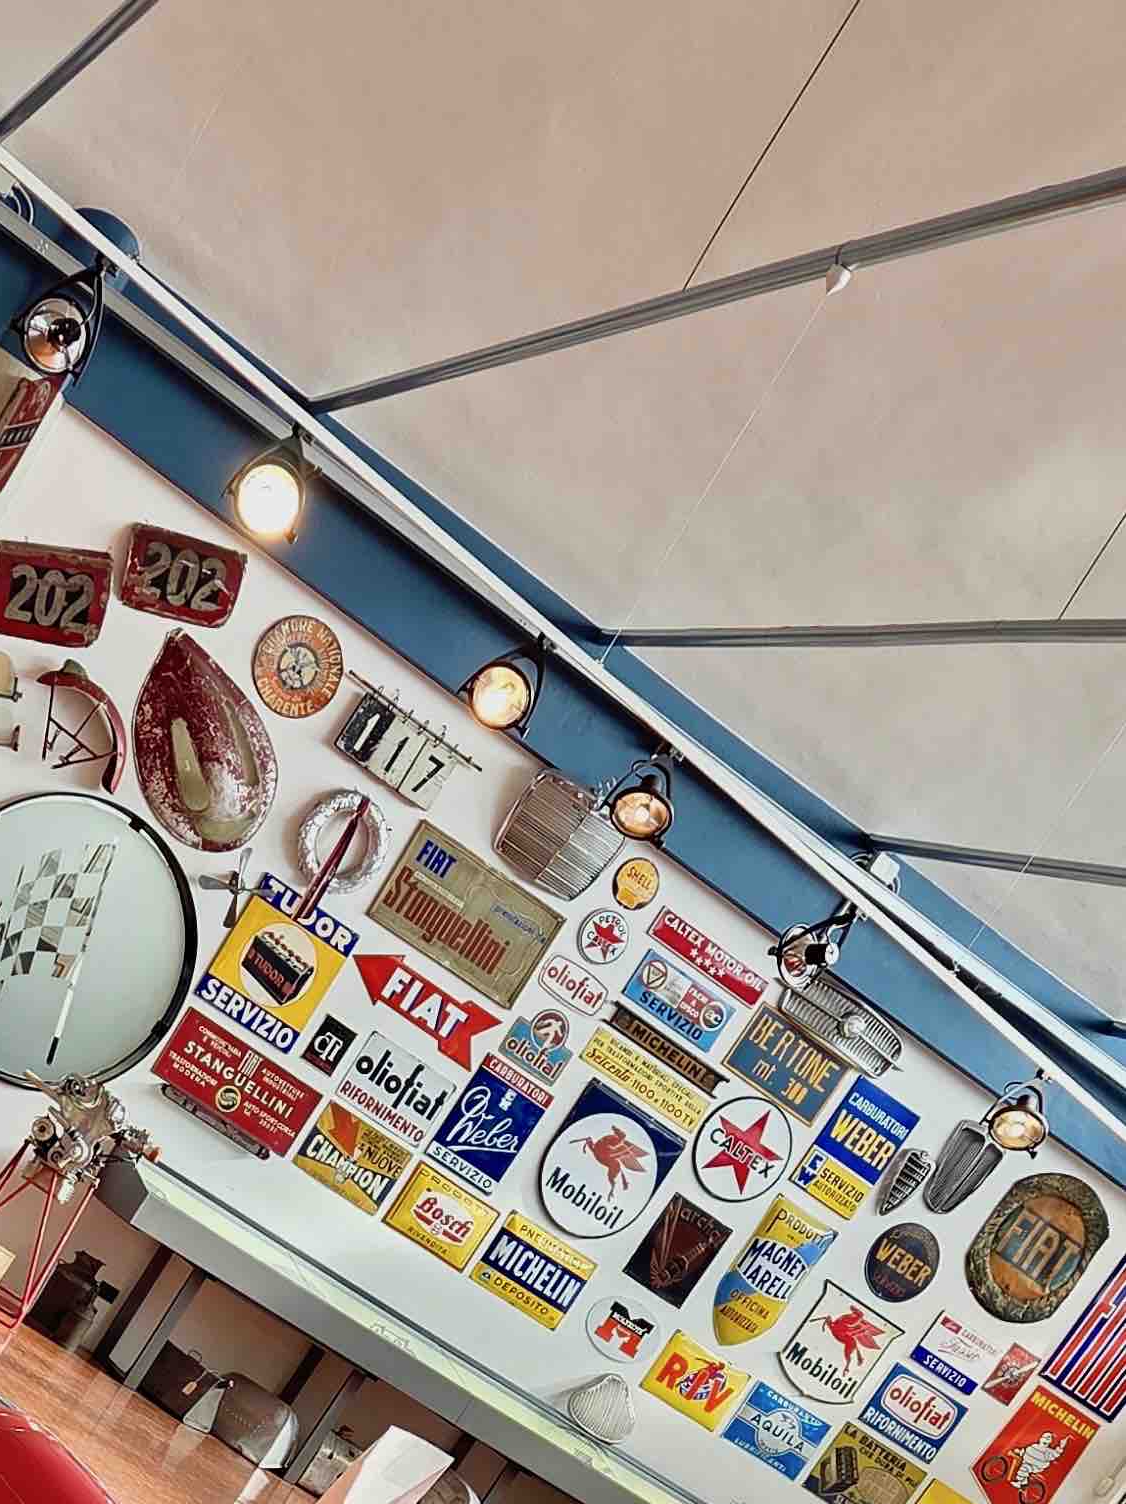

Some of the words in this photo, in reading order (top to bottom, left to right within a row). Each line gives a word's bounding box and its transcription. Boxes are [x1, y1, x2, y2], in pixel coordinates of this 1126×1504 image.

[4, 563, 96, 633] 202
[141, 542, 226, 612] 202
[415, 839, 457, 878] FIAT
[627, 867, 652, 890] SHELL
[382, 864, 511, 975] Stanguellini
[599, 914, 627, 937] PETROL
[664, 912, 703, 947] CALTEX
[704, 938, 742, 976] MOTOR
[745, 966, 762, 992] OIL
[380, 966, 469, 1038] FIAT
[547, 963, 603, 1009] oliofiat
[201, 977, 294, 1049] SERVIZIO
[640, 990, 703, 1041] SERVIZIO
[632, 1023, 702, 1080] MICHELIN
[749, 1013, 841, 1093] BERTONE
[184, 1041, 294, 1119] STANGUELLINI
[355, 1049, 448, 1121] oliofiat
[489, 1057, 548, 1107] CARBURATORI
[339, 1080, 424, 1142] RIFORNIMENTO
[848, 1092, 910, 1141] CARBURATORI
[709, 1127, 775, 1179] CALTEX
[830, 1110, 896, 1171] WEBER
[432, 1145, 493, 1190] SERVIZIO
[820, 1167, 864, 1203] SERVIZIO
[414, 1191, 474, 1238] Bosch
[544, 1165, 625, 1230] Mobiloil
[813, 1180, 857, 1213] AUTORIZZATO
[488, 1234, 583, 1308] MICHELIN
[873, 1236, 932, 1287] WEBER
[995, 1208, 1084, 1290] FIAT
[493, 1276, 550, 1316] DEPOSITO
[656, 1351, 734, 1414] RIV
[785, 1341, 859, 1399] Mobiloil
[922, 1354, 967, 1387] SERVIZIO
[750, 1413, 805, 1453] AQUILA
[888, 1384, 952, 1431] oliofiat
[1031, 1391, 1096, 1440] MICHELIN
[859, 1434, 908, 1472] BATTERIA
[863, 1407, 938, 1461] RIFORNIMENTO
